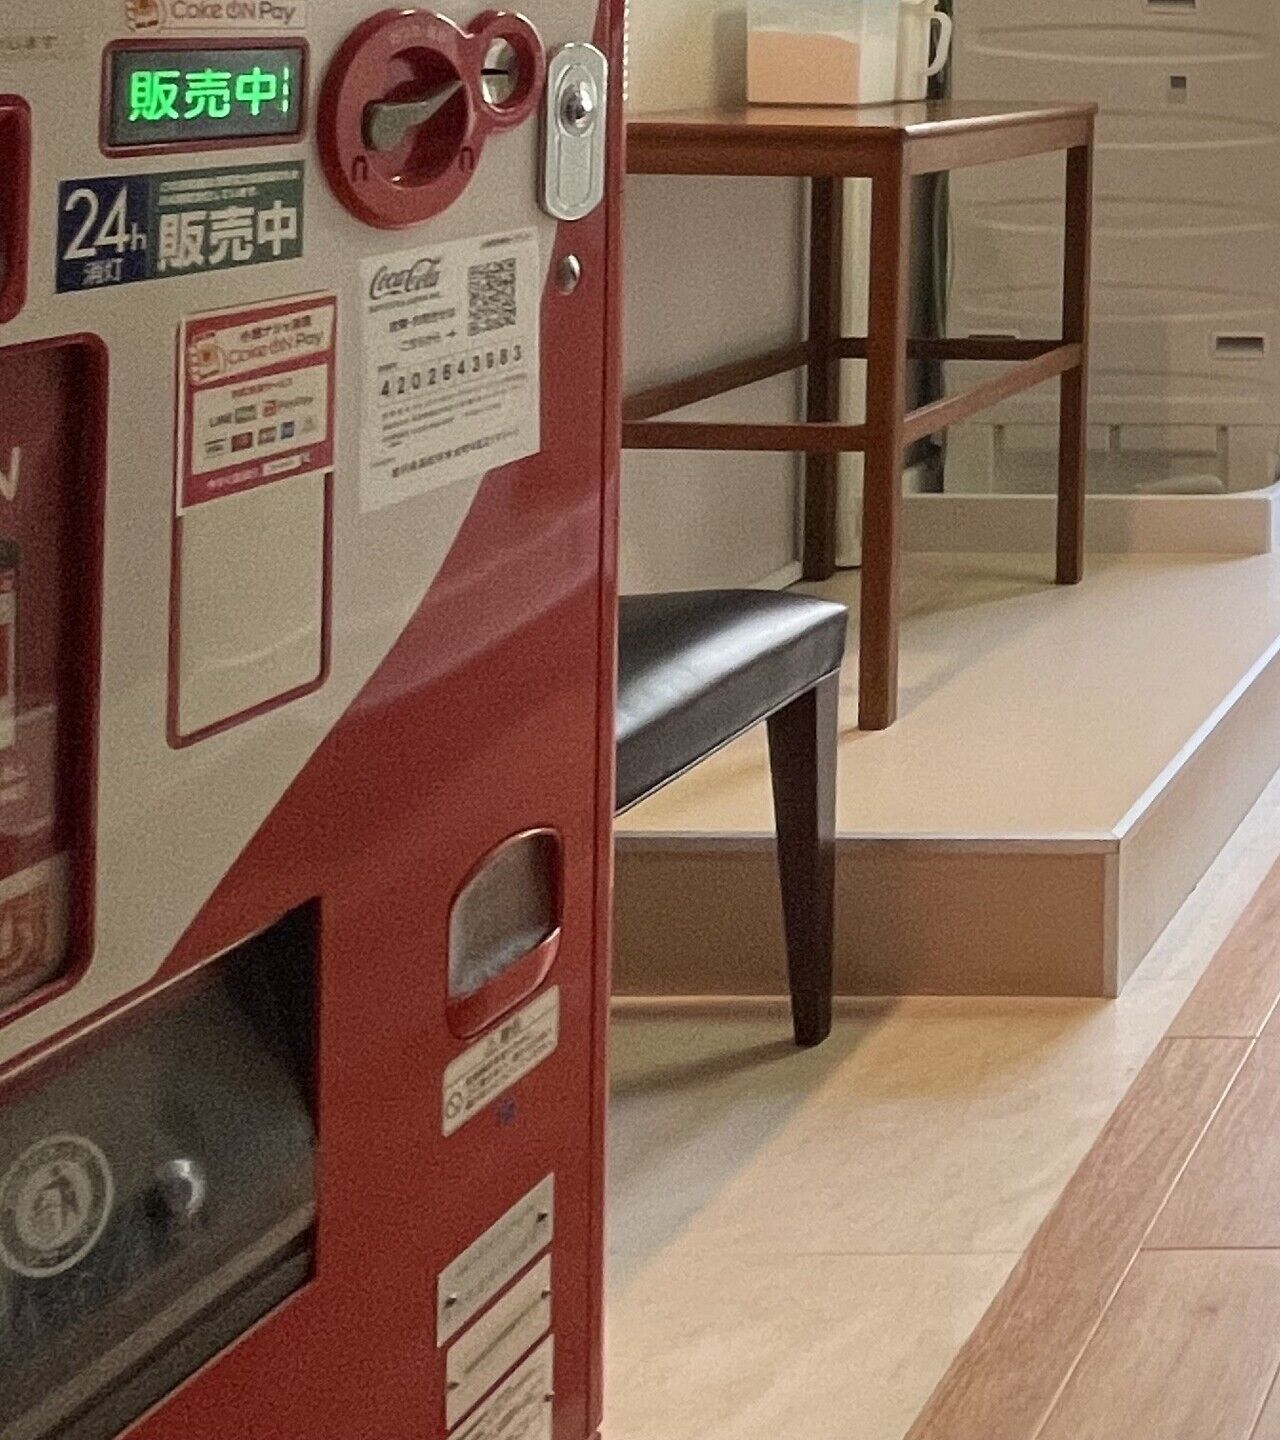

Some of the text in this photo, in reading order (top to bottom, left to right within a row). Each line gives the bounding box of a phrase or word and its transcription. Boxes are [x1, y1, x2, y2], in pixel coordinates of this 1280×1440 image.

[171, 0, 223, 20] Coke
[258, 0, 297, 25] Pay
[156, 200, 298, 272] 販売中
